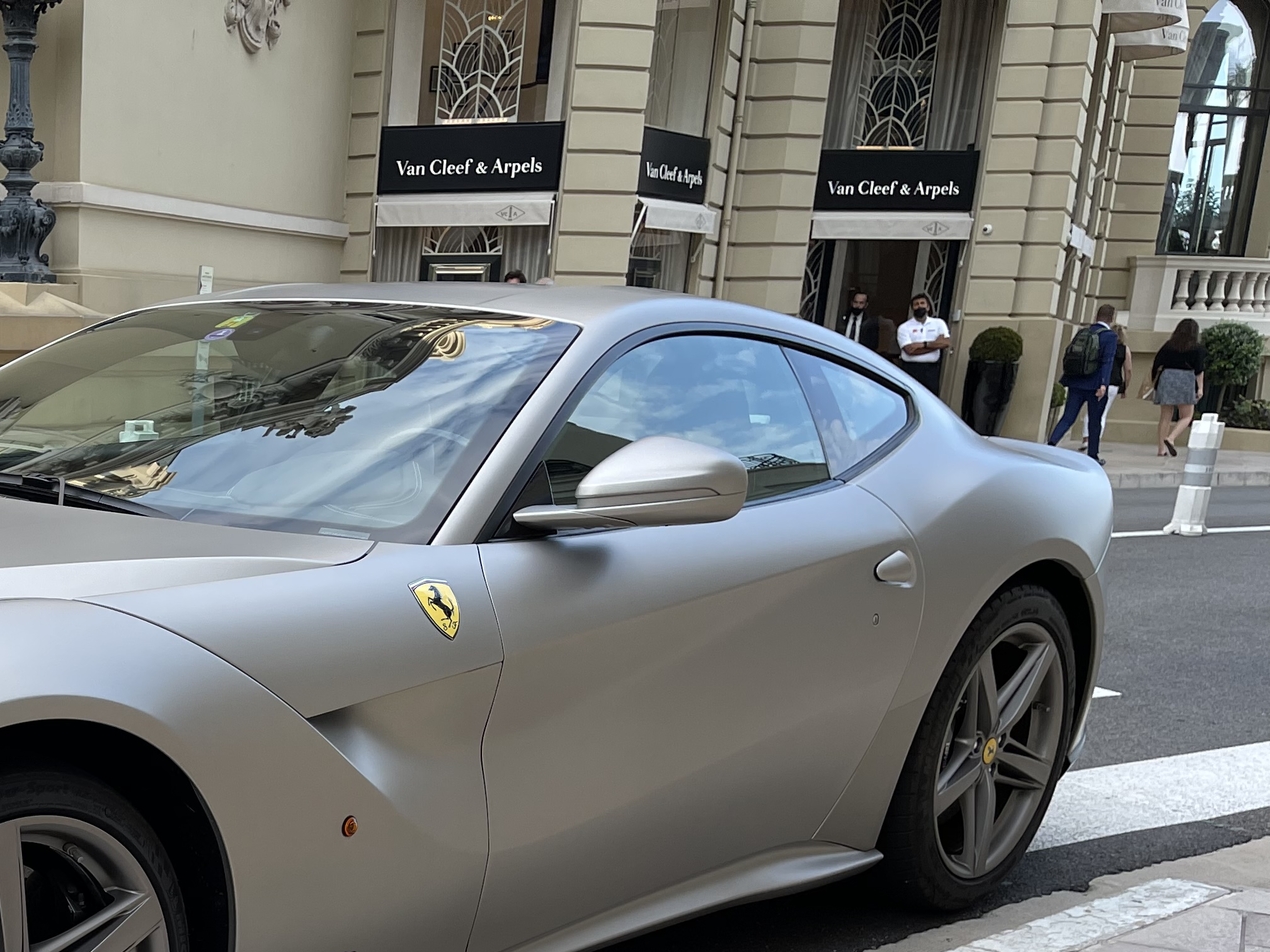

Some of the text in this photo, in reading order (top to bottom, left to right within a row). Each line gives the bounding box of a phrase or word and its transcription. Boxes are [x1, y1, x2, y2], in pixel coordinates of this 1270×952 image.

[396, 156, 543, 179] Van Cleef & Arpels
[646, 161, 703, 189] Van Cleef & Arpels
[827, 180, 960, 200] Van Cleef & Arpels
